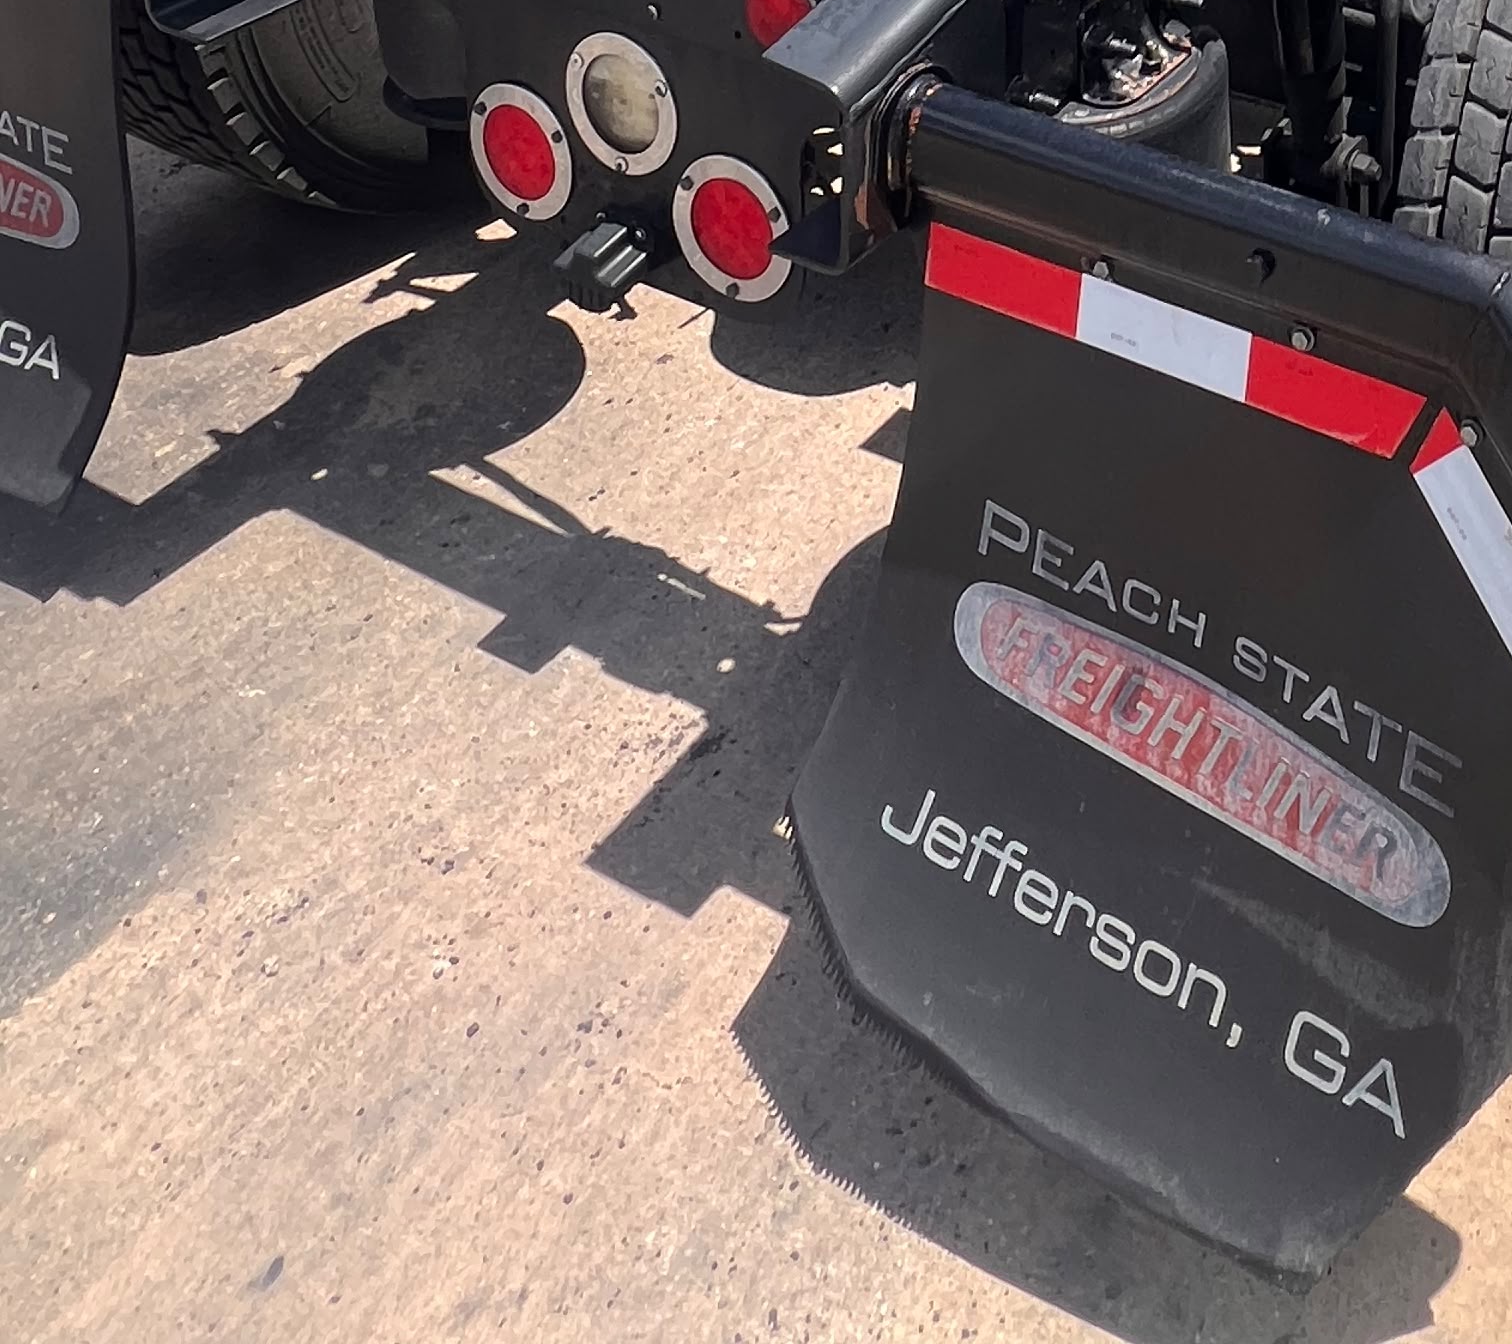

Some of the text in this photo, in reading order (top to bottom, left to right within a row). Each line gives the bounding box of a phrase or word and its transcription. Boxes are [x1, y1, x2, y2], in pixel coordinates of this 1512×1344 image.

[978, 499, 1463, 818] PEACH STATE
[997, 616, 1400, 885] FREIGHTLINER
[881, 789, 1406, 1140] Jefferson, GA
